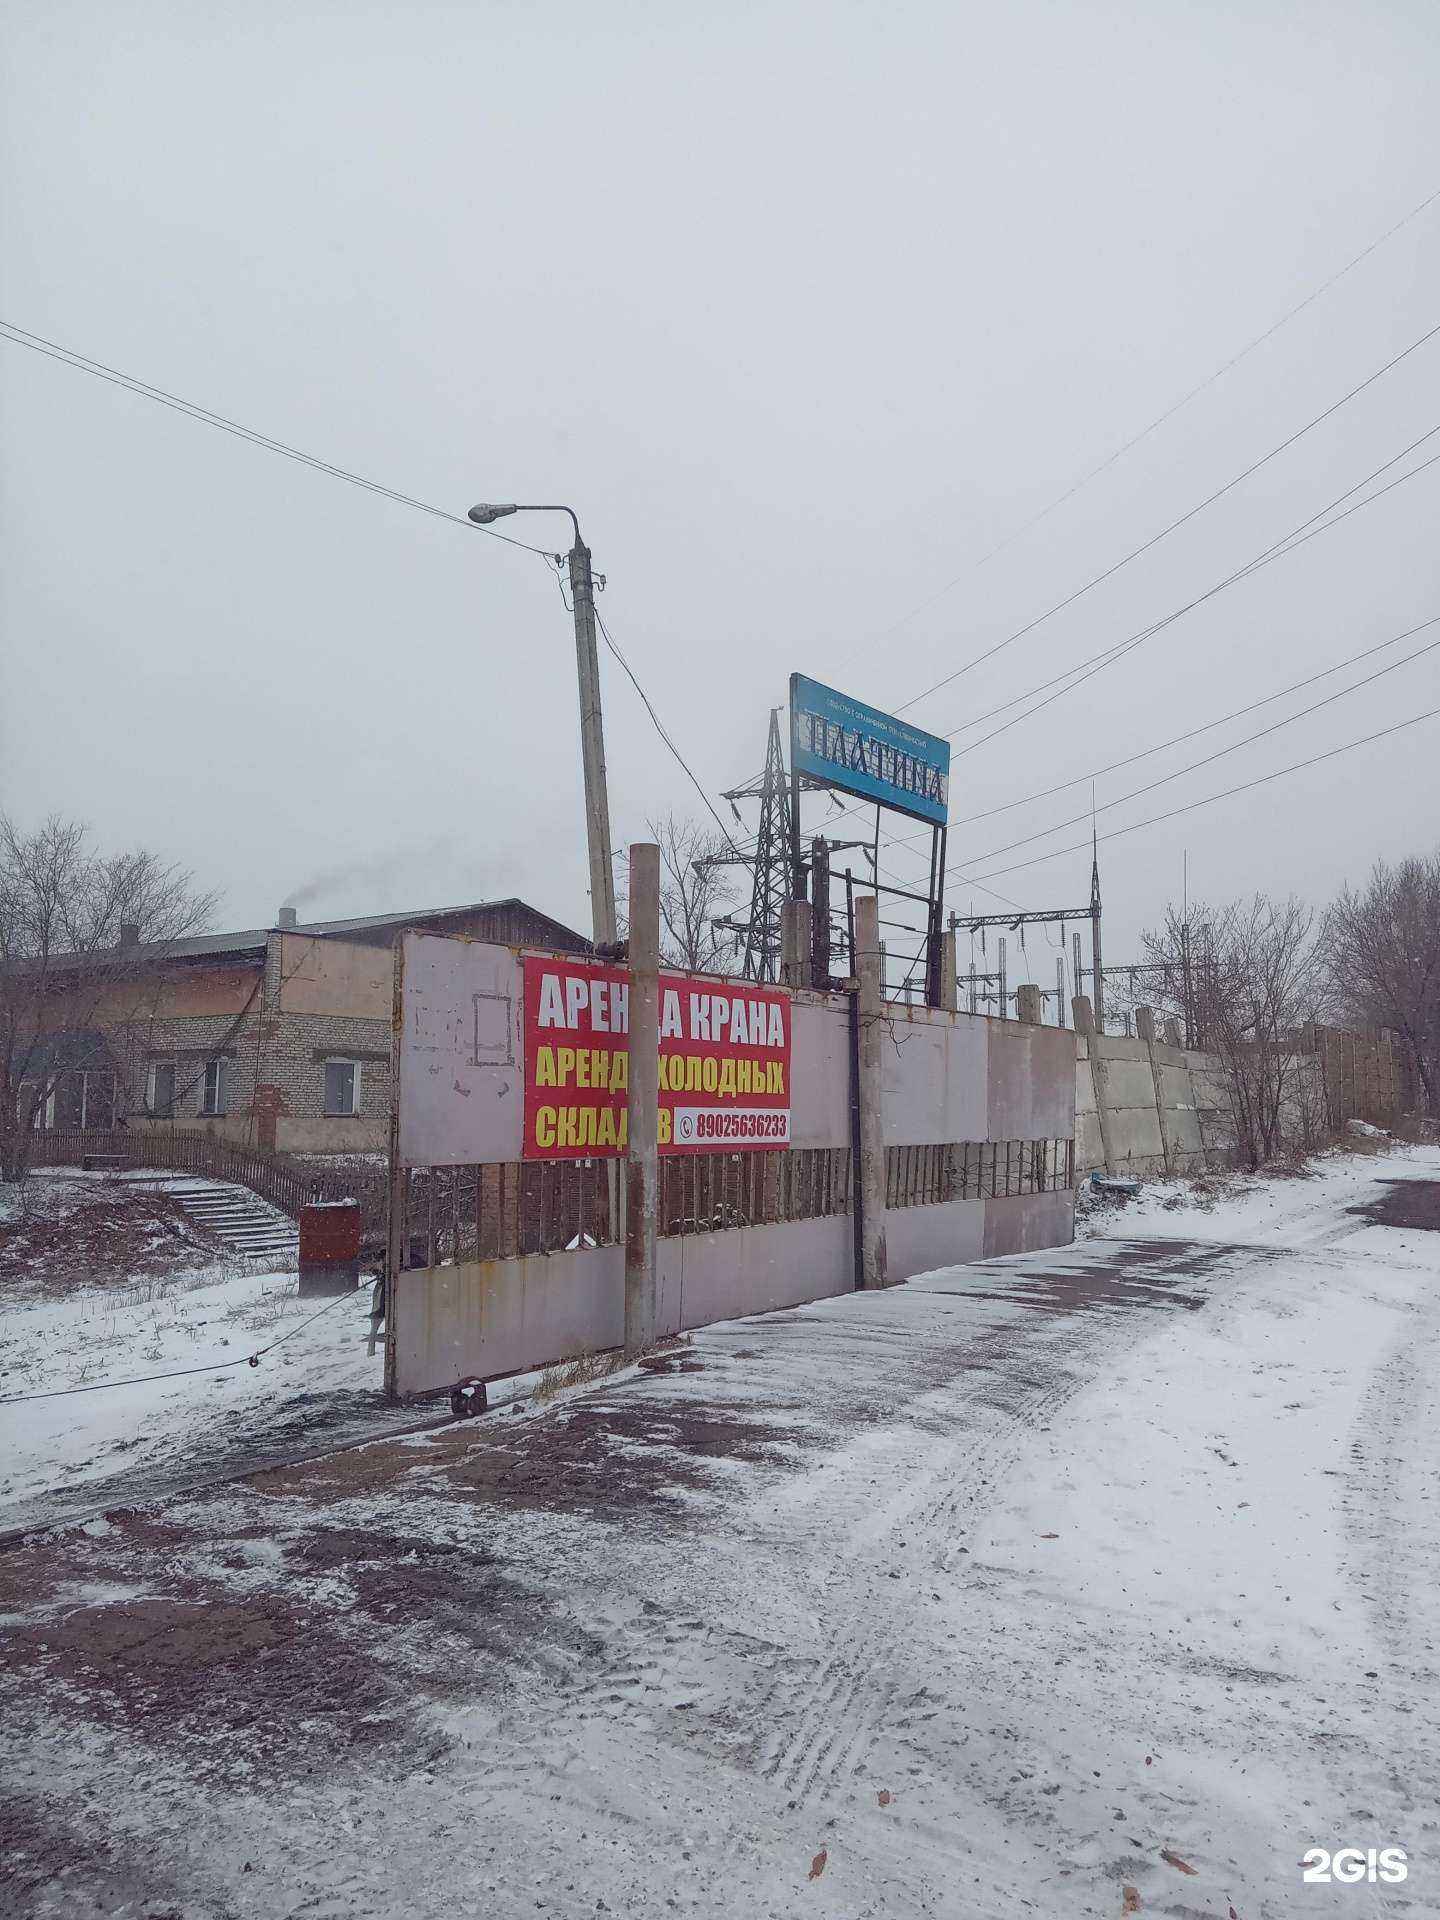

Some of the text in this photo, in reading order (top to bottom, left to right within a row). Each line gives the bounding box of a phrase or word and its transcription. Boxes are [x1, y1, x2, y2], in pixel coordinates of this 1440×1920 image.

[538, 973, 785, 1048] АРЕНА КРАНА
[535, 1046, 785, 1098] АРЕНД ХОЛОДНЫХ
[535, 1106, 672, 1151] СКЛАДВ
[696, 1114, 787, 1138] 89025636233
